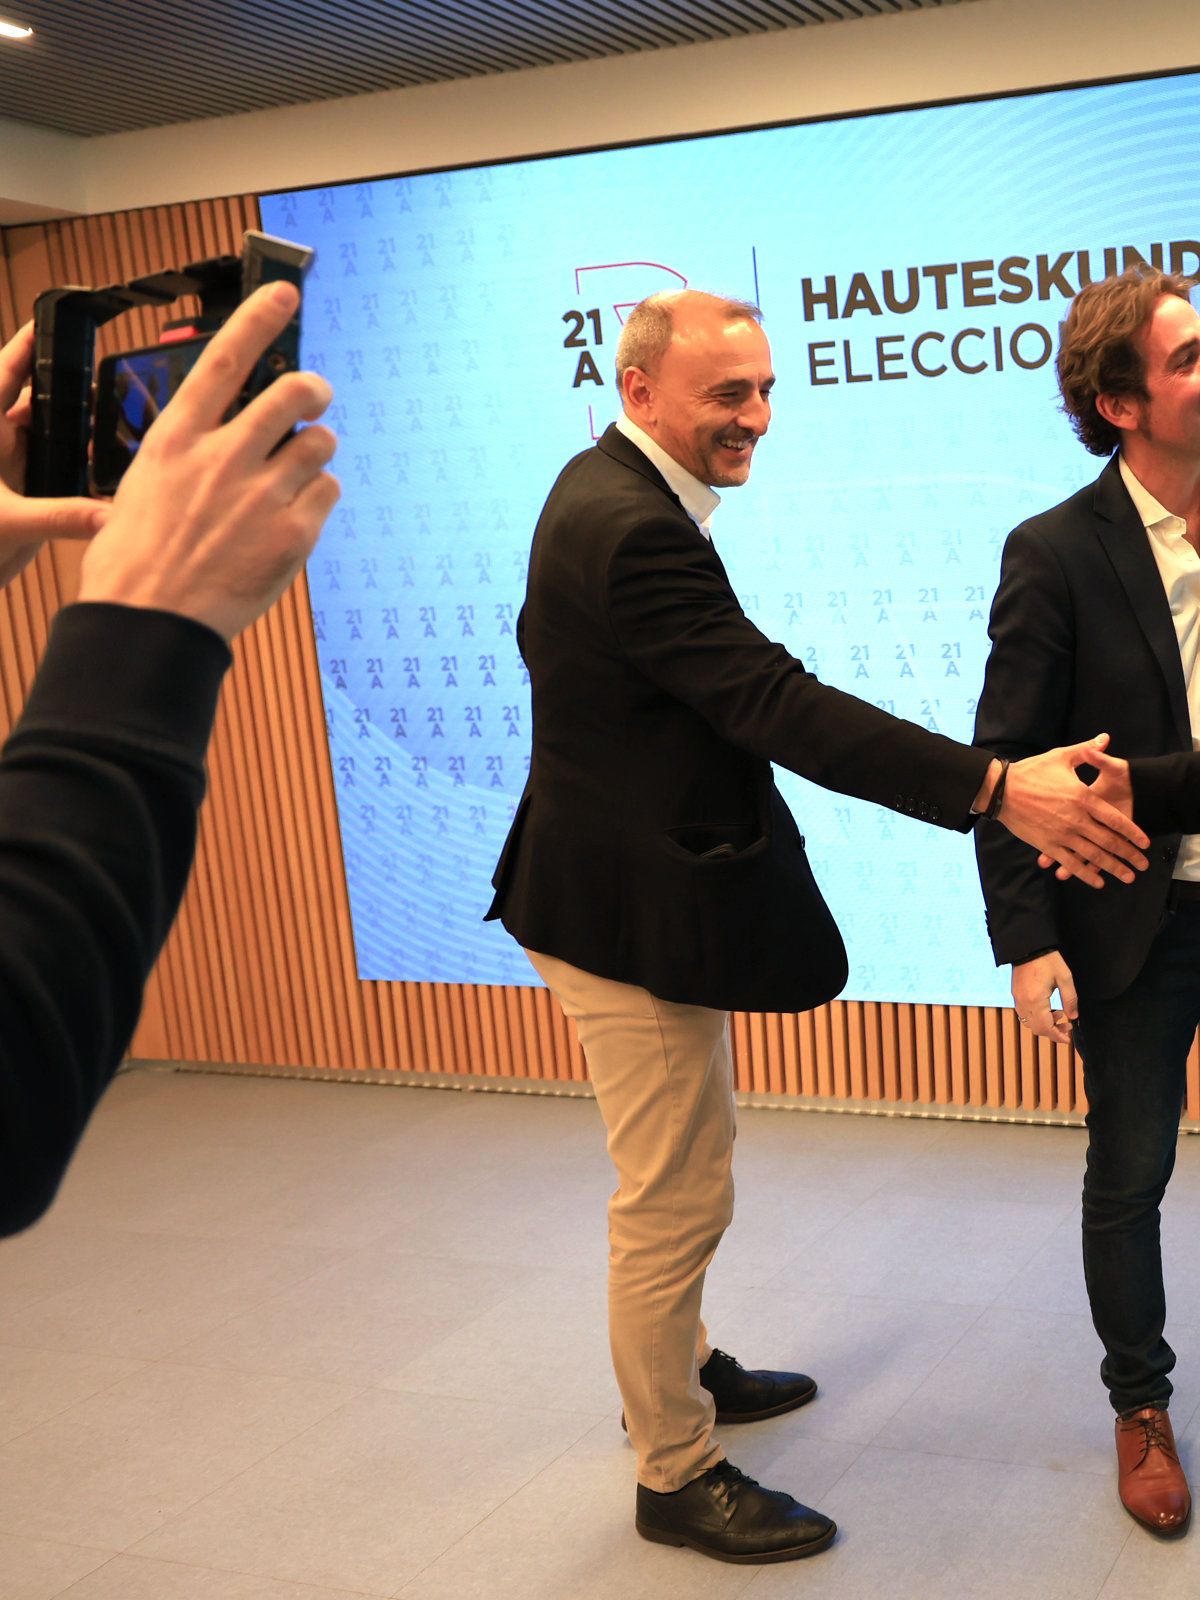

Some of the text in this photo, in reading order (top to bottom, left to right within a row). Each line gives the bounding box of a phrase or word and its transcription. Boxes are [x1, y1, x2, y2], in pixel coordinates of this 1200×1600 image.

[562, 308, 603, 348] 21
[808, 322, 1058, 386] ELECCIO
[572, 350, 604, 388] A
[784, 593, 802, 608] 21
[873, 589, 892, 605] 21
[919, 588, 938, 603] 21
[964, 586, 985, 602] 21
[420, 607, 436, 621] 21
[457, 605, 474, 620] 21
[496, 604, 513, 619] 21
[316, 620, 512, 641] A A A A A A
[851, 642, 961, 661] 21 21 21
[331, 655, 496, 674] 21 21 21 21 21
[856, 661, 960, 678] A A A
[336, 672, 496, 689] A A A A A
[354, 706, 520, 722] 21 21 21 21 21
[921, 699, 941, 715] 21
[359, 722, 520, 738] A A A A A
[927, 716, 940, 732] A
[339, 756, 503, 771] 21 21 21 21 21
[344, 772, 503, 787] A A A A A
